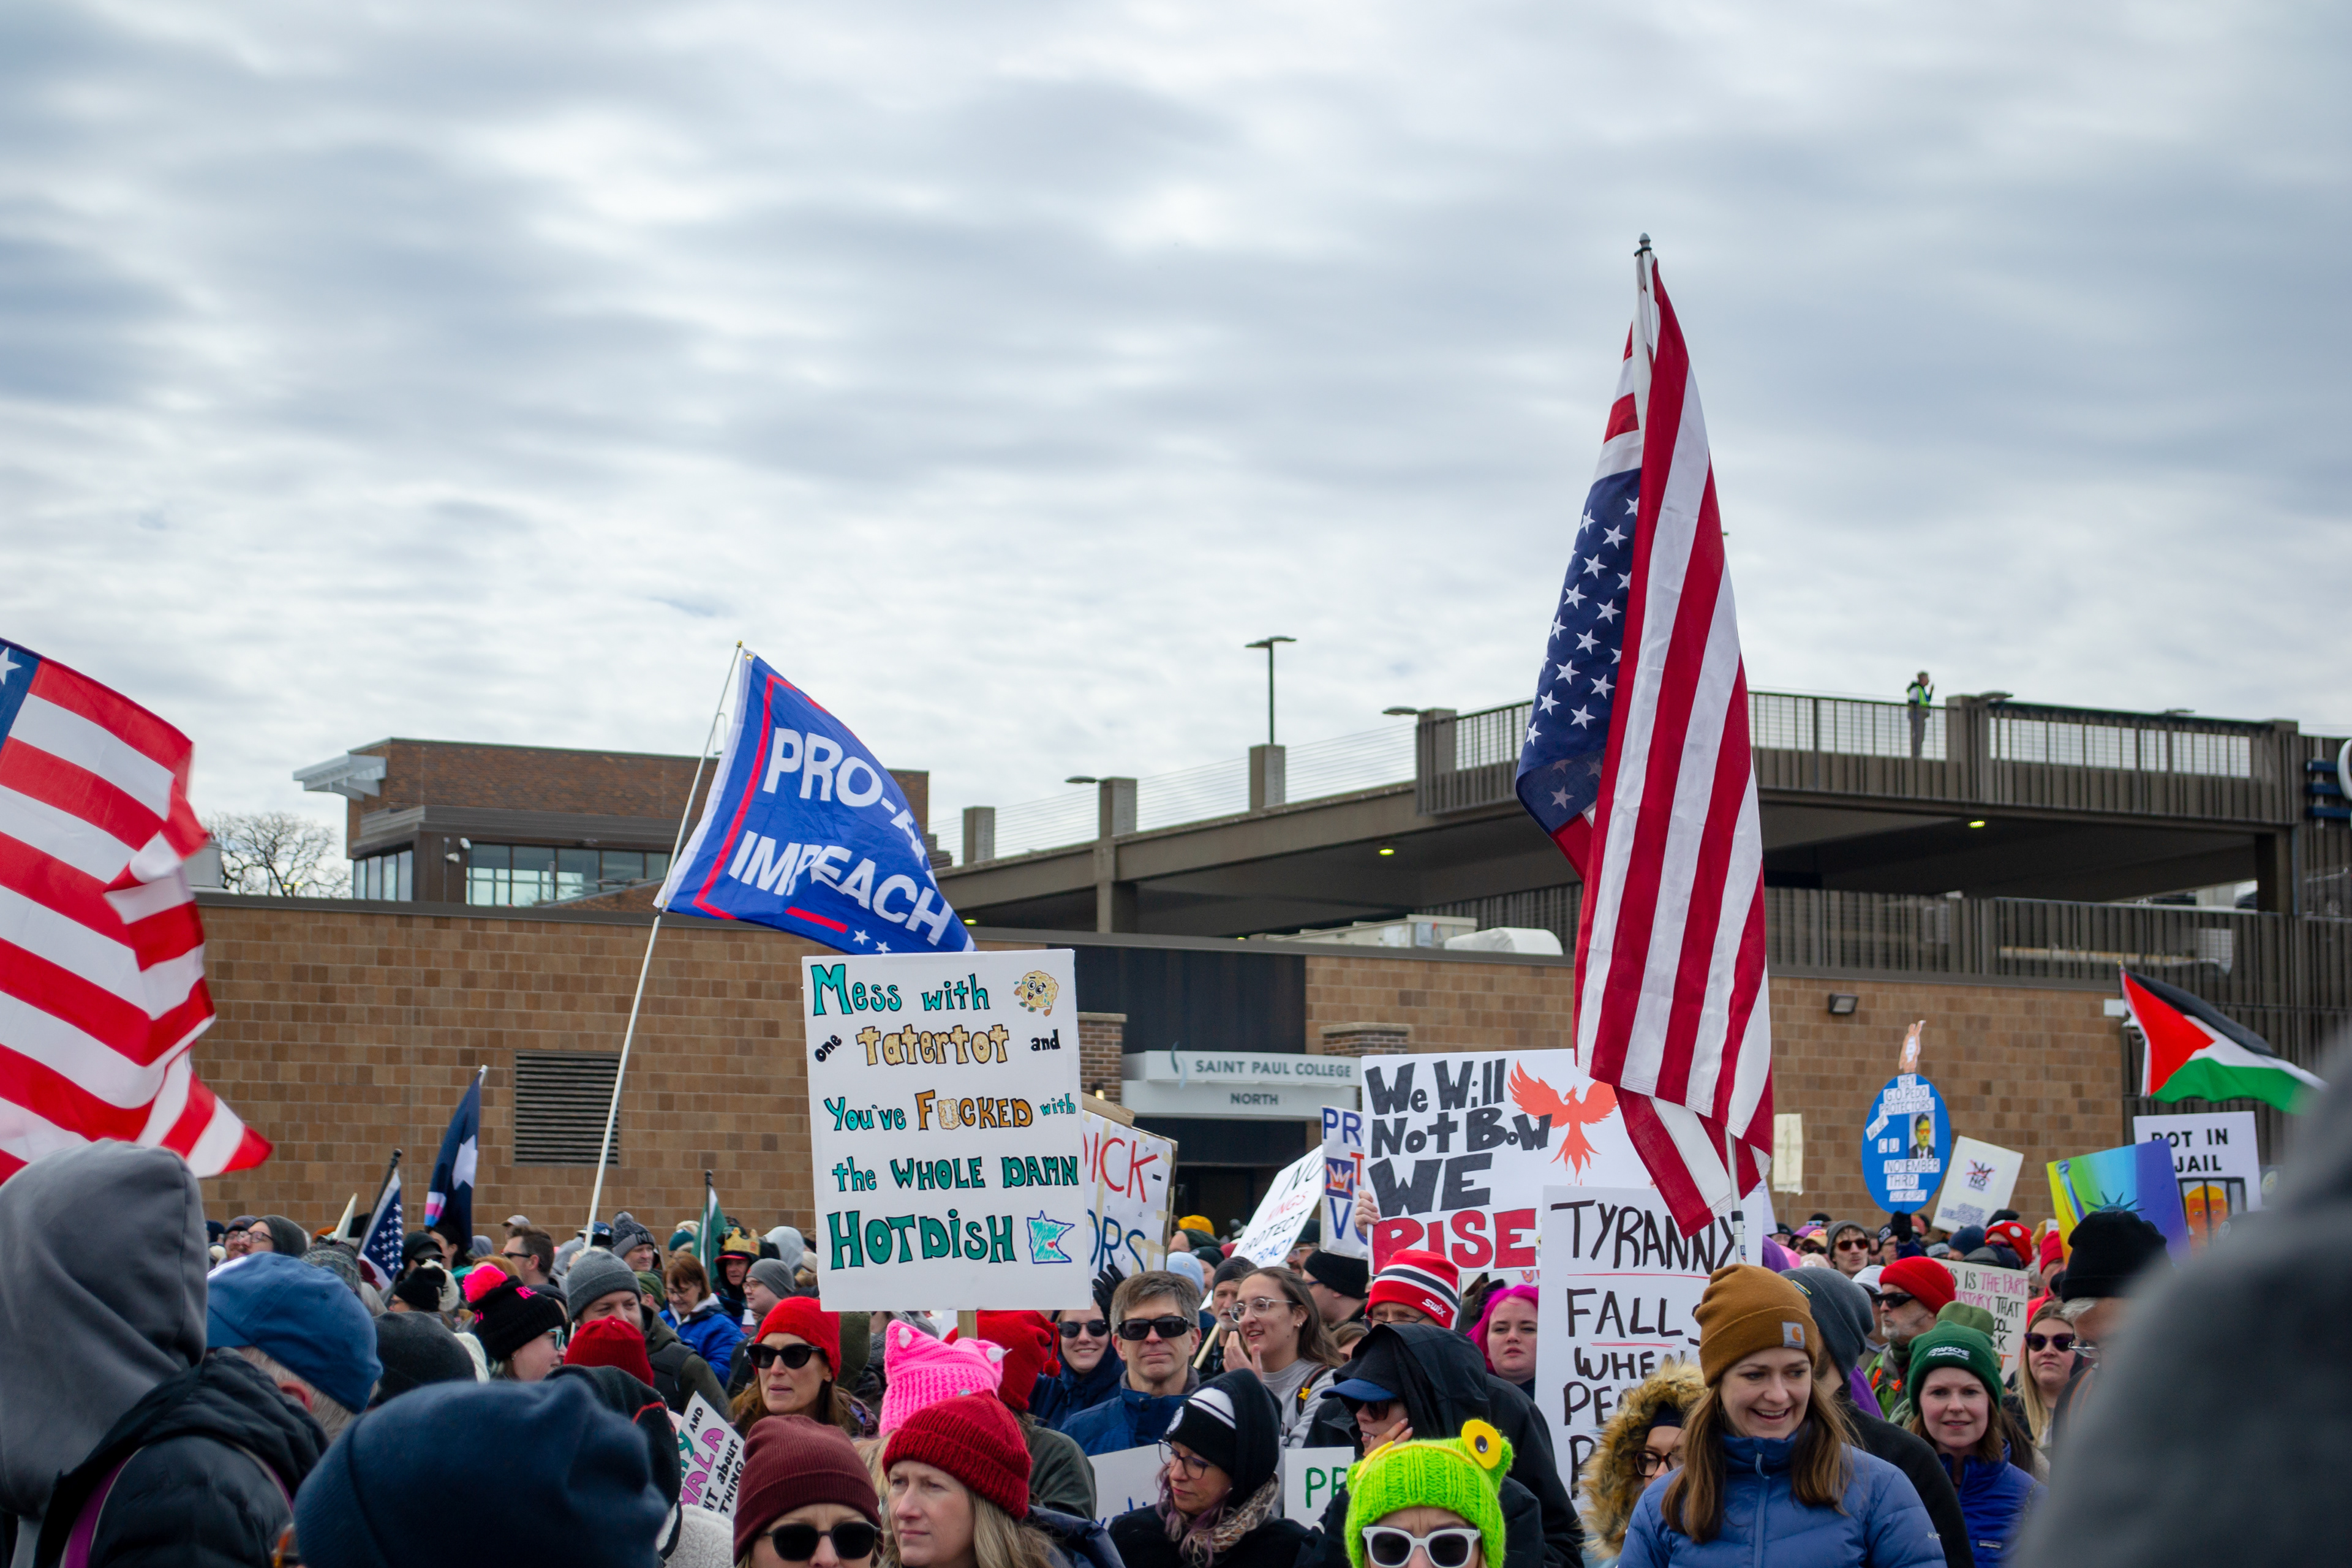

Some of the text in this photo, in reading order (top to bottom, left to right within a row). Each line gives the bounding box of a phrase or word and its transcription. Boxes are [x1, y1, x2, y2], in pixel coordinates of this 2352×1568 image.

[728, 831, 952, 946] IMPEACH
[810, 963, 990, 1016] Mess with
[814, 1024, 1061, 1066] one tatertot and
[1196, 1060, 1351, 1077] SAINT PAUL COLLEGE
[1365, 1058, 1506, 1115] We Will
[1900, 1076, 1914, 1086] HEY
[824, 1089, 1076, 1131] You've FUCKED with
[1231, 1093, 1279, 1105] NORTH
[1371, 1112, 1458, 1158] Not
[1890, 1139, 1899, 1152] U
[2207, 1128, 2228, 1145] IN
[832, 1156, 1079, 1192] the WHOLE DAMN
[1083, 1132, 1162, 1203] ICK-
[2175, 1155, 2222, 1172] JAIL
[1368, 1153, 1493, 1218] WE
[1264, 1191, 1309, 1224] KINGS
[1240, 1208, 1310, 1256] PROTECT
[1252, 1232, 1298, 1264] CRACY
[1372, 1208, 1537, 1275] RISE
[1550, 1199, 1746, 1275] TYRANNY
[1965, 1270, 1977, 1289] IS
[1979, 1272, 2001, 1294] THE
[2002, 1273, 2029, 1295] PART
[1954, 1290, 2025, 1318] ISTORY THAT
[689, 1407, 703, 1433] AND
[680, 1428, 725, 1506] MALA
[717, 1439, 739, 1485] about
